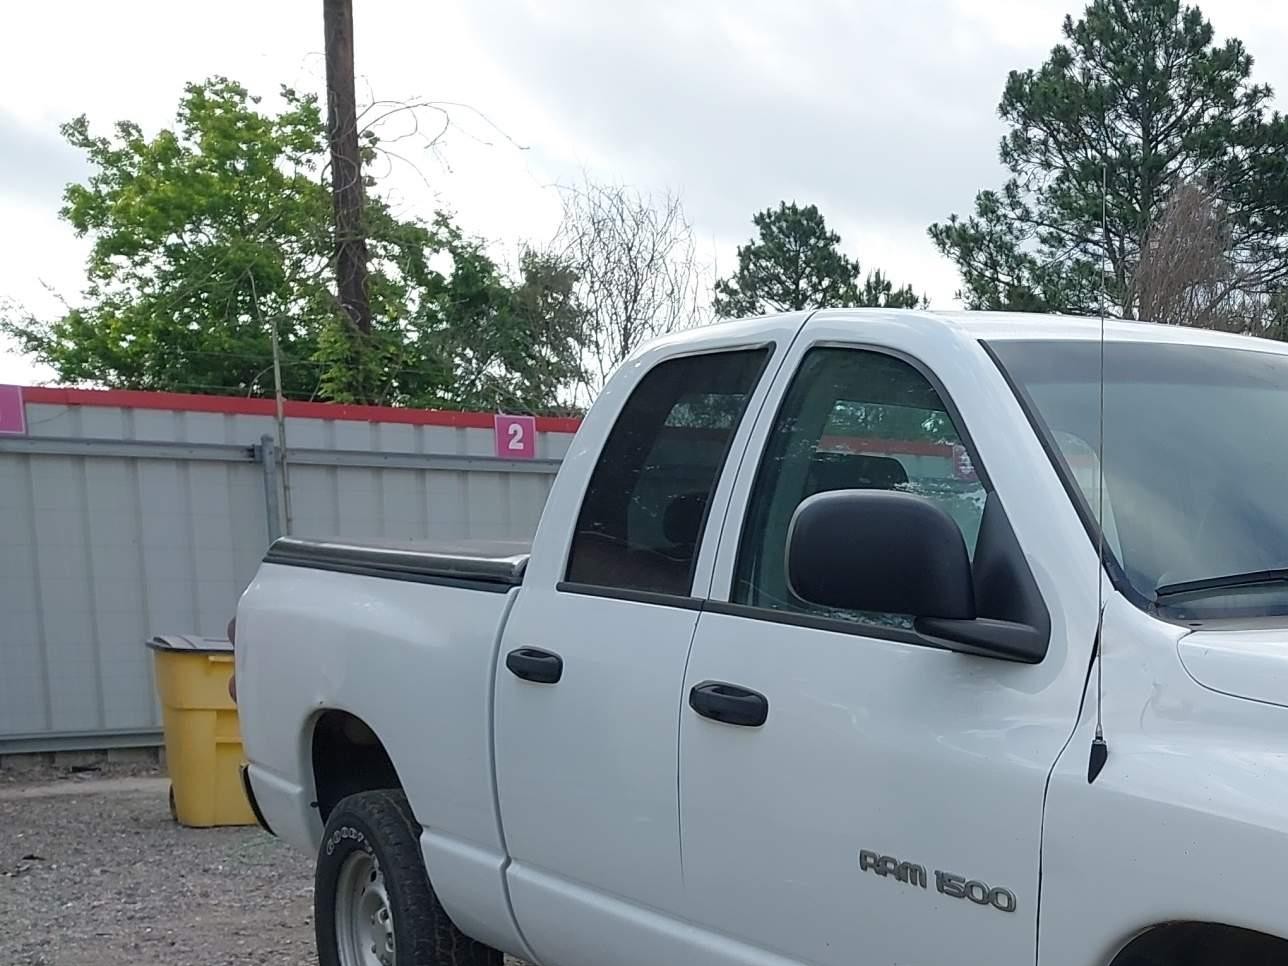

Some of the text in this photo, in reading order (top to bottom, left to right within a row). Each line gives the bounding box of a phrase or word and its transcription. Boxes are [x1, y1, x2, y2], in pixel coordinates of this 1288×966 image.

[508, 423, 524, 450] 2
[859, 849, 1018, 913] RAM 1500
